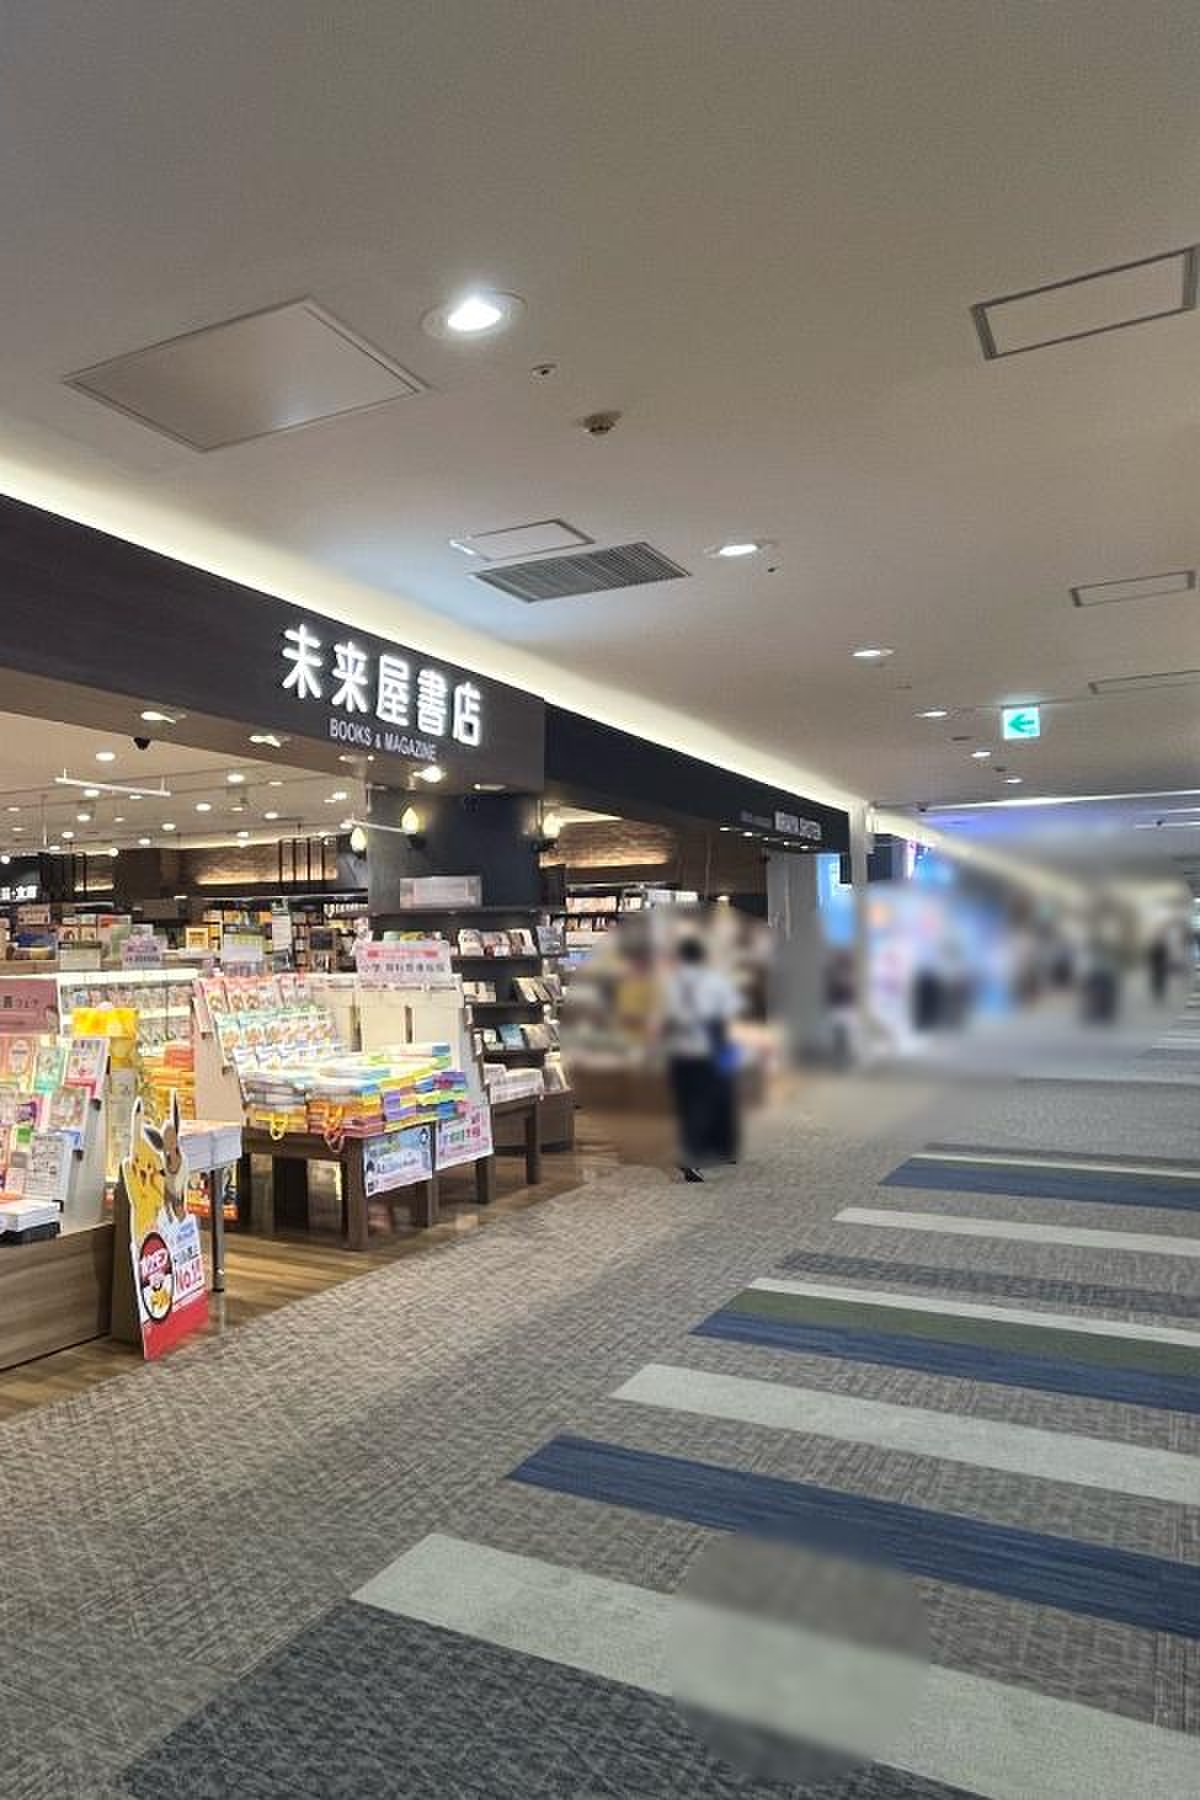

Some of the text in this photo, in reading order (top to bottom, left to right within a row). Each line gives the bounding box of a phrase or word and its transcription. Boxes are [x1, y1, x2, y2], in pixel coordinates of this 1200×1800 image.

[281, 624, 481, 747] 未来屋書店
[329, 718, 371, 747] BOOKS
[384, 732, 437, 762] MAGAZINE
